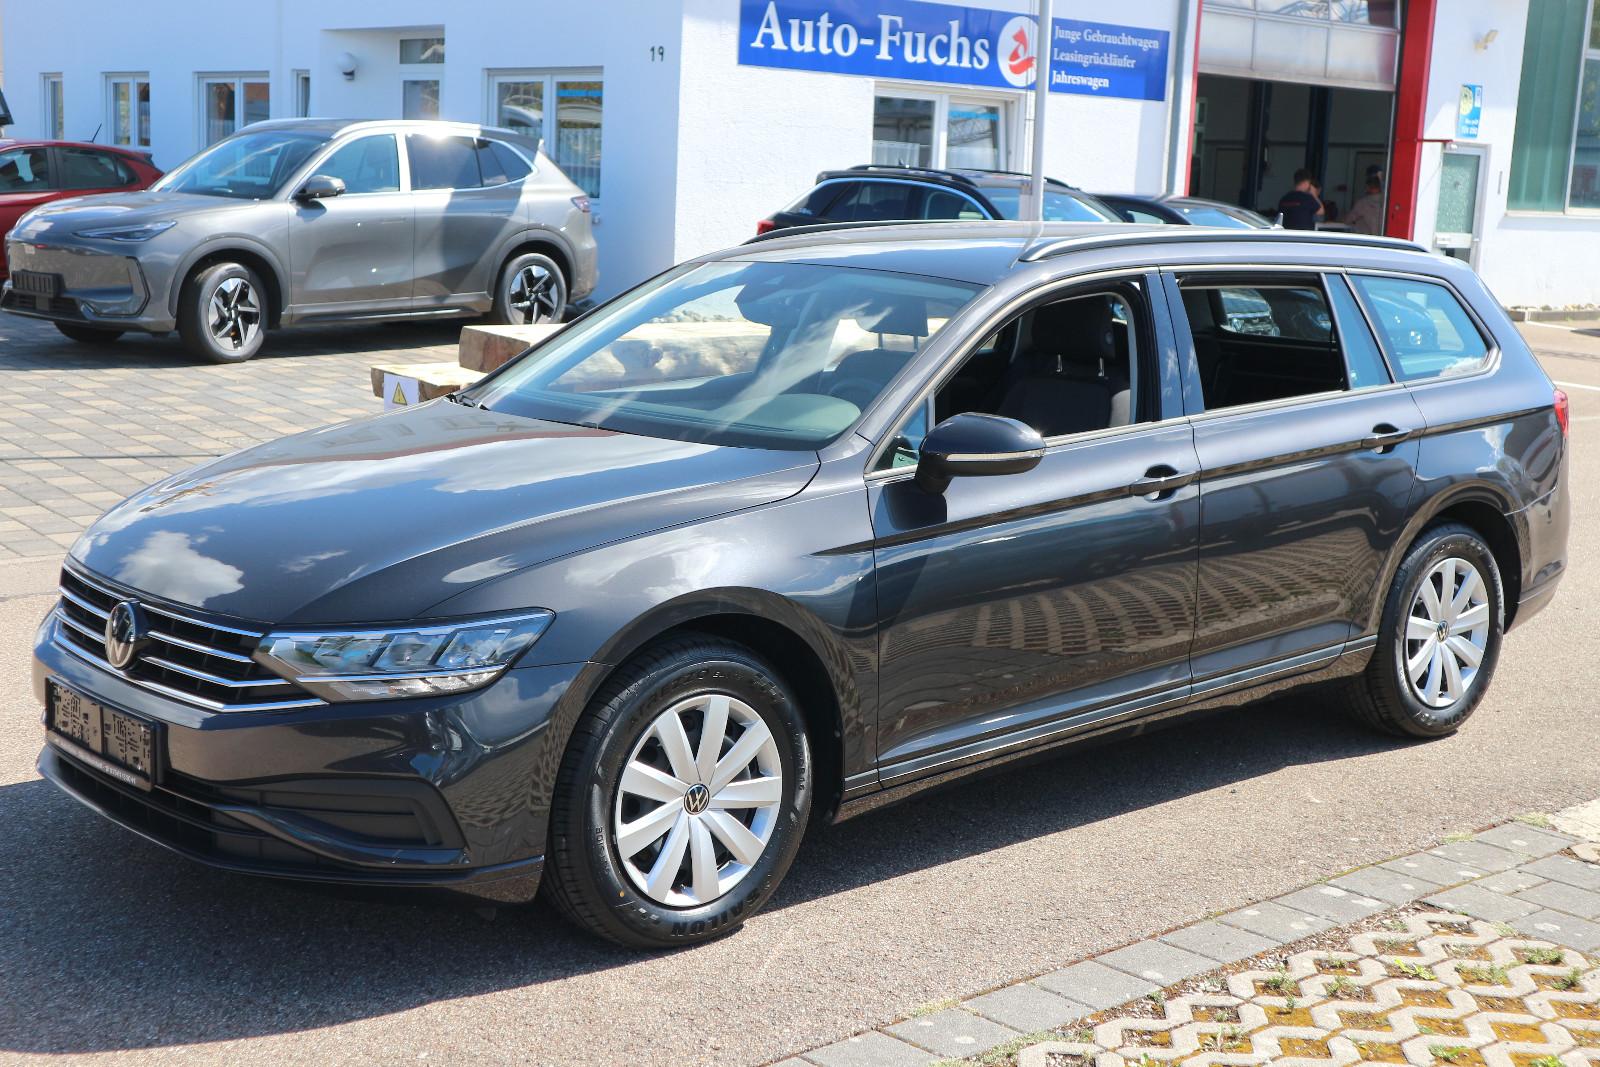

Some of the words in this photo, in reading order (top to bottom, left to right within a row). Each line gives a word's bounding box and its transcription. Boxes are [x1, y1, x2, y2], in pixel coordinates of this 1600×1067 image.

[750, 1, 990, 70] Auto-Fuchs
[1055, 25, 1081, 43] Junge
[1083, 28, 1159, 51] Gebrauchtwagen
[650, 46, 664, 62] 19
[1053, 47, 1136, 68] Leasingrückläufer
[1051, 70, 1110, 90] Jahreswagen
